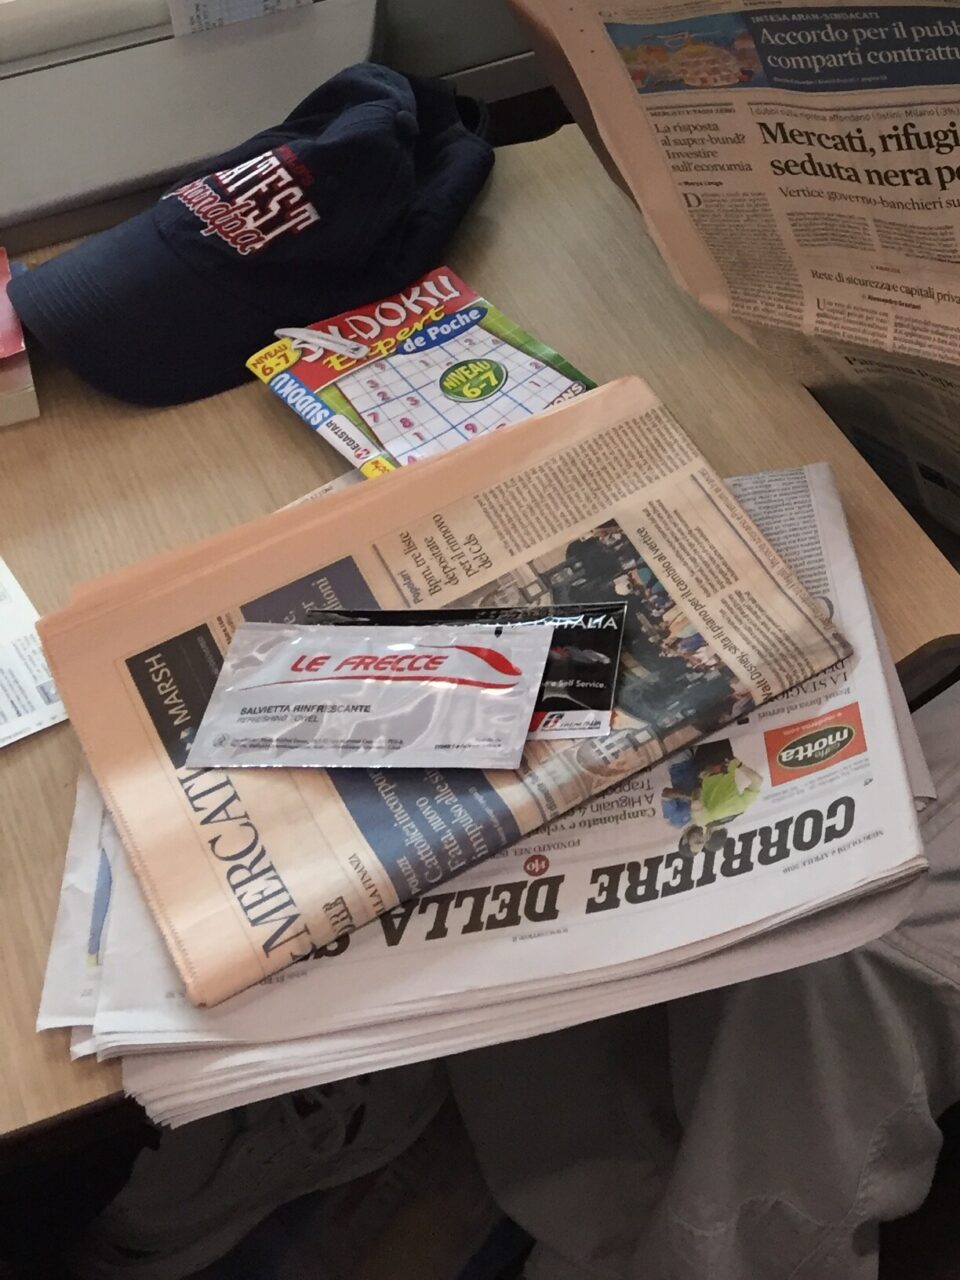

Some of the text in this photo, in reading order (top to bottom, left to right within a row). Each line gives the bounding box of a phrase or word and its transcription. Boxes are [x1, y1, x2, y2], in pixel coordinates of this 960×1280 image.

[761, 22, 850, 46] Accordo
[852, 24, 893, 45] per
[895, 20, 909, 39] il
[767, 46, 861, 74] comparti
[904, 108, 936, 118] Milano
[756, 121, 876, 156] Mercati,
[770, 154, 861, 184] seduta
[864, 166, 935, 188] nera
[778, 186, 825, 200] Vertice
[826, 191, 944, 211] governo-banchieri
[945, 197, 960, 209] su
[899, 284, 936, 300] capitali
[402, 308, 482, 354] de Poche
[251, 343, 288, 370] NIVEAU
[260, 354, 291, 378] 6-7
[442, 359, 492, 391] NIVEAU
[461, 370, 499, 399] 6-7
[269, 372, 331, 427] SUDOKU
[324, 418, 372, 461] MEGASTAR
[430, 512, 479, 578] per il rinnovo
[460, 532, 493, 572] del Cds
[634, 525, 661, 556] vertice
[394, 529, 445, 596] Bpm, tre liste
[420, 532, 462, 589] depositate
[653, 551, 667, 565] al
[397, 568, 424, 605] Popolari
[659, 559, 689, 593] cambio
[681, 588, 693, 599] il
[687, 592, 705, 612] per
[697, 605, 723, 633] piano
[713, 629, 725, 640] il
[718, 634, 739, 657] salta
[290, 654, 450, 672] LE FRECCE
[829, 671, 849, 686] LA
[142, 650, 192, 727] MARSH
[240, 703, 291, 716] SALVIETTA
[779, 728, 849, 763] motta
[430, 780, 458, 809] alle
[589, 791, 655, 812] A Higuain
[414, 793, 469, 872] Fata, nuovo
[445, 798, 494, 860] impulso
[578, 807, 657, 832] Campionato
[177, 766, 311, 960] MERCATI
[397, 819, 446, 885] Cattolica
[583, 795, 857, 916] CORRIERE
[378, 874, 566, 948] DELLA
